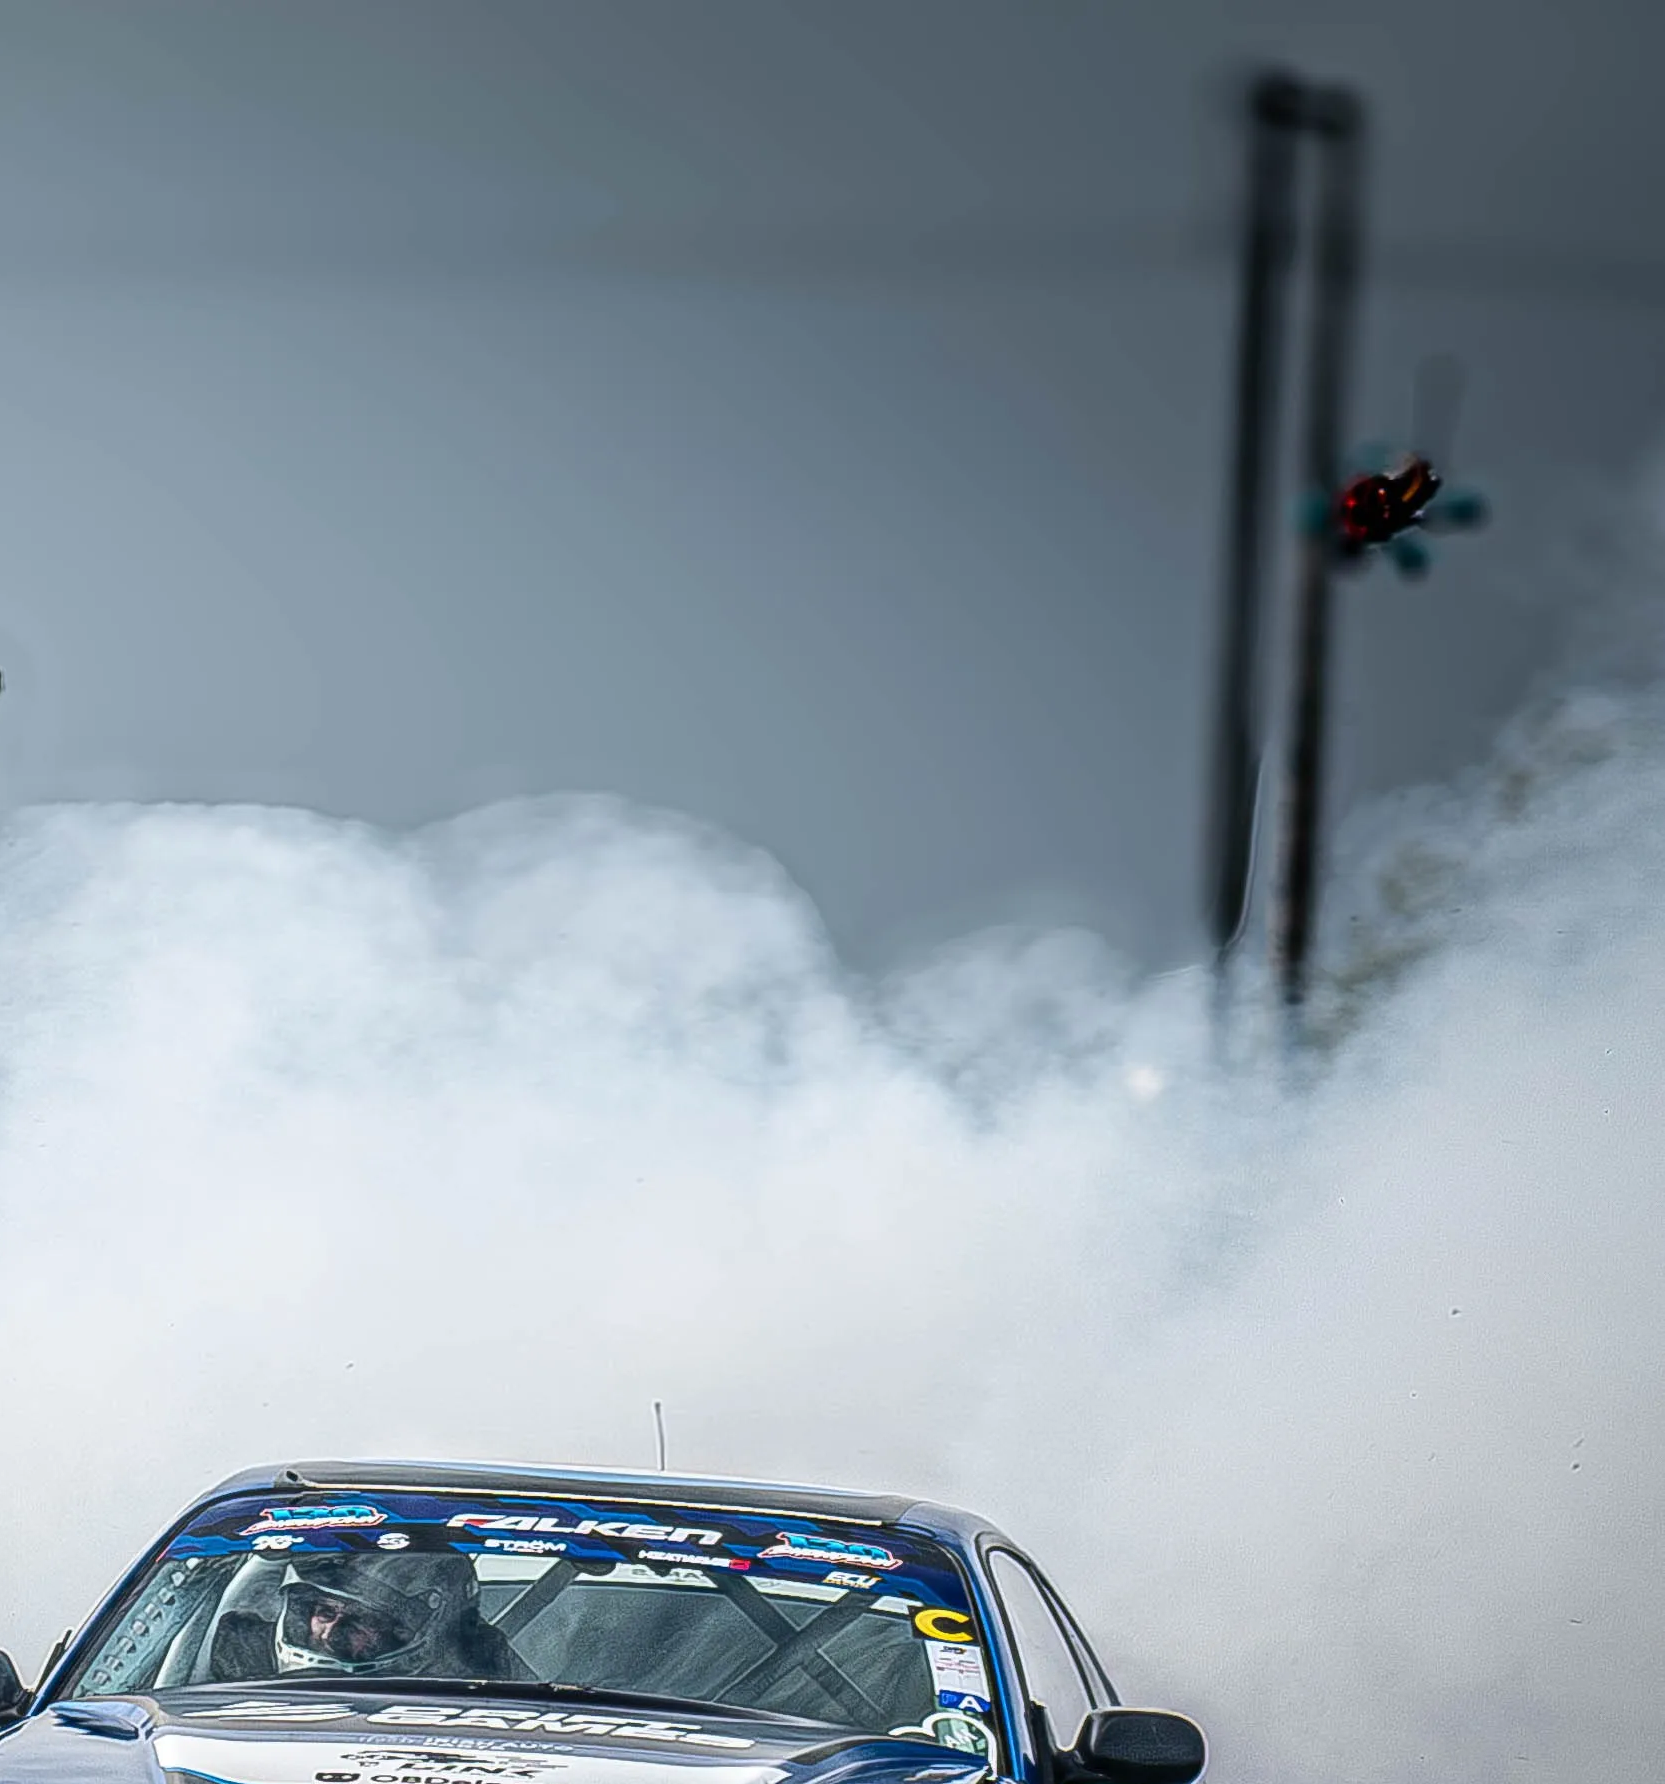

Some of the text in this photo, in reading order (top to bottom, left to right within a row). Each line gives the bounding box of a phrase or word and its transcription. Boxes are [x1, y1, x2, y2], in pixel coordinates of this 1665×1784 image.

[446, 1514, 723, 1546] FALKEN
[914, 1609, 974, 1642] C
[367, 1713, 756, 1749] GAMES
[380, 1706, 703, 1730] DRIFT
